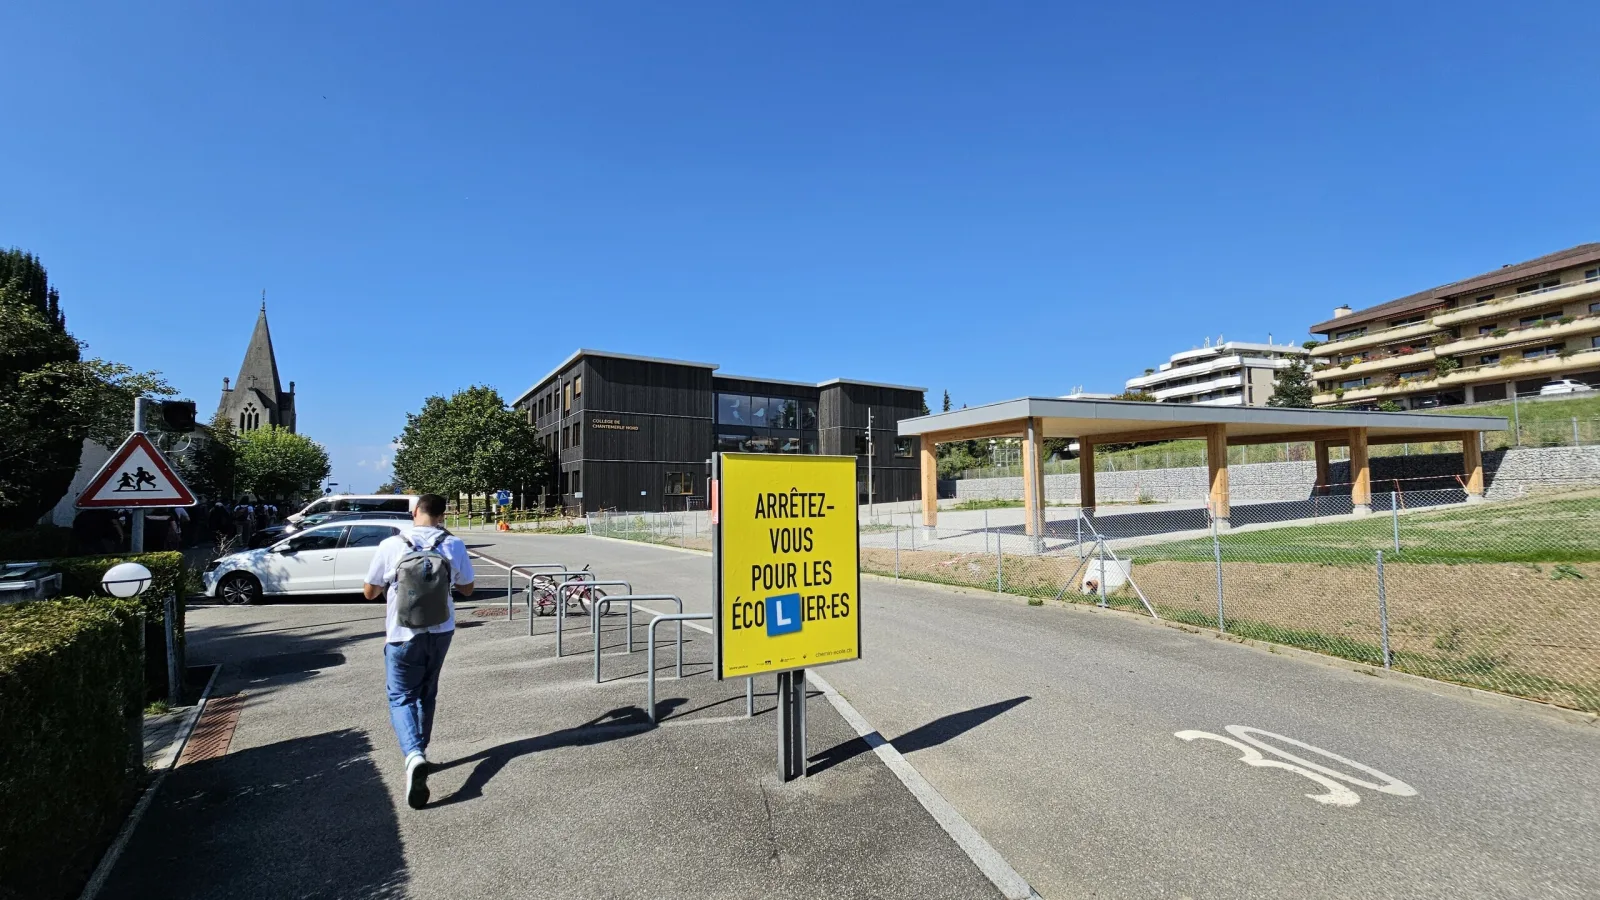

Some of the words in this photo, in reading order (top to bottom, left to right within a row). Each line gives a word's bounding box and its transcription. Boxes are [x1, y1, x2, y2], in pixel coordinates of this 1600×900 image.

[755, 487, 834, 519] ARRÊTEZ-
[769, 527, 813, 553] VOUS
[752, 562, 797, 591] POUR
[803, 560, 832, 586] LES
[1173, 724, 1418, 807] 30
